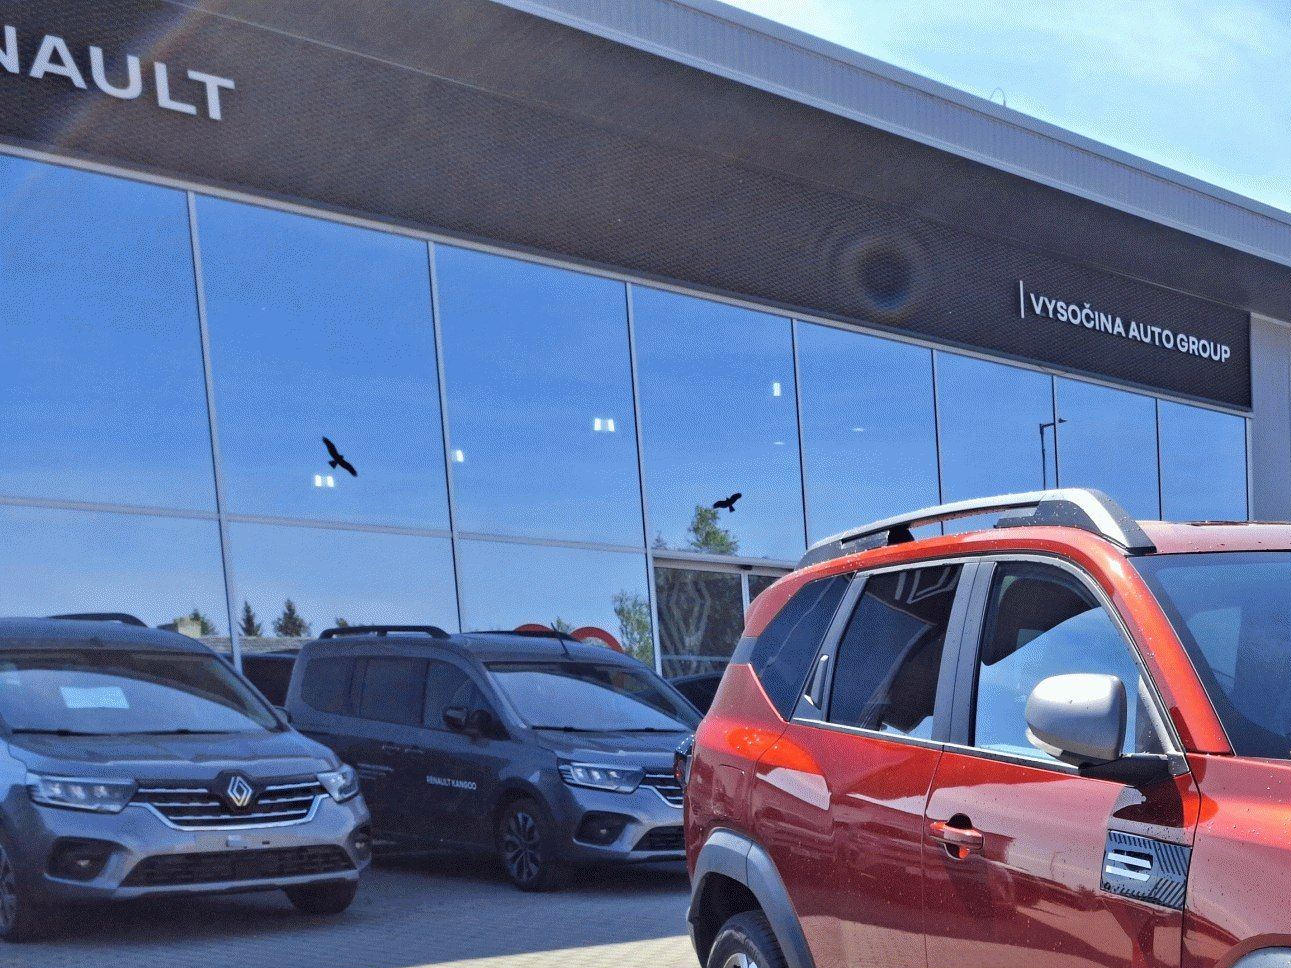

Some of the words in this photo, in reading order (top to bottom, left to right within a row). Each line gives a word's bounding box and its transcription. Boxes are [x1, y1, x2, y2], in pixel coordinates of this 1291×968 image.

[1030, 293, 1126, 338] VYSOČINA
[1128, 321, 1175, 349] AUTO
[1177, 333, 1231, 362] GROUP
[452, 779, 477, 790] KANGOO
